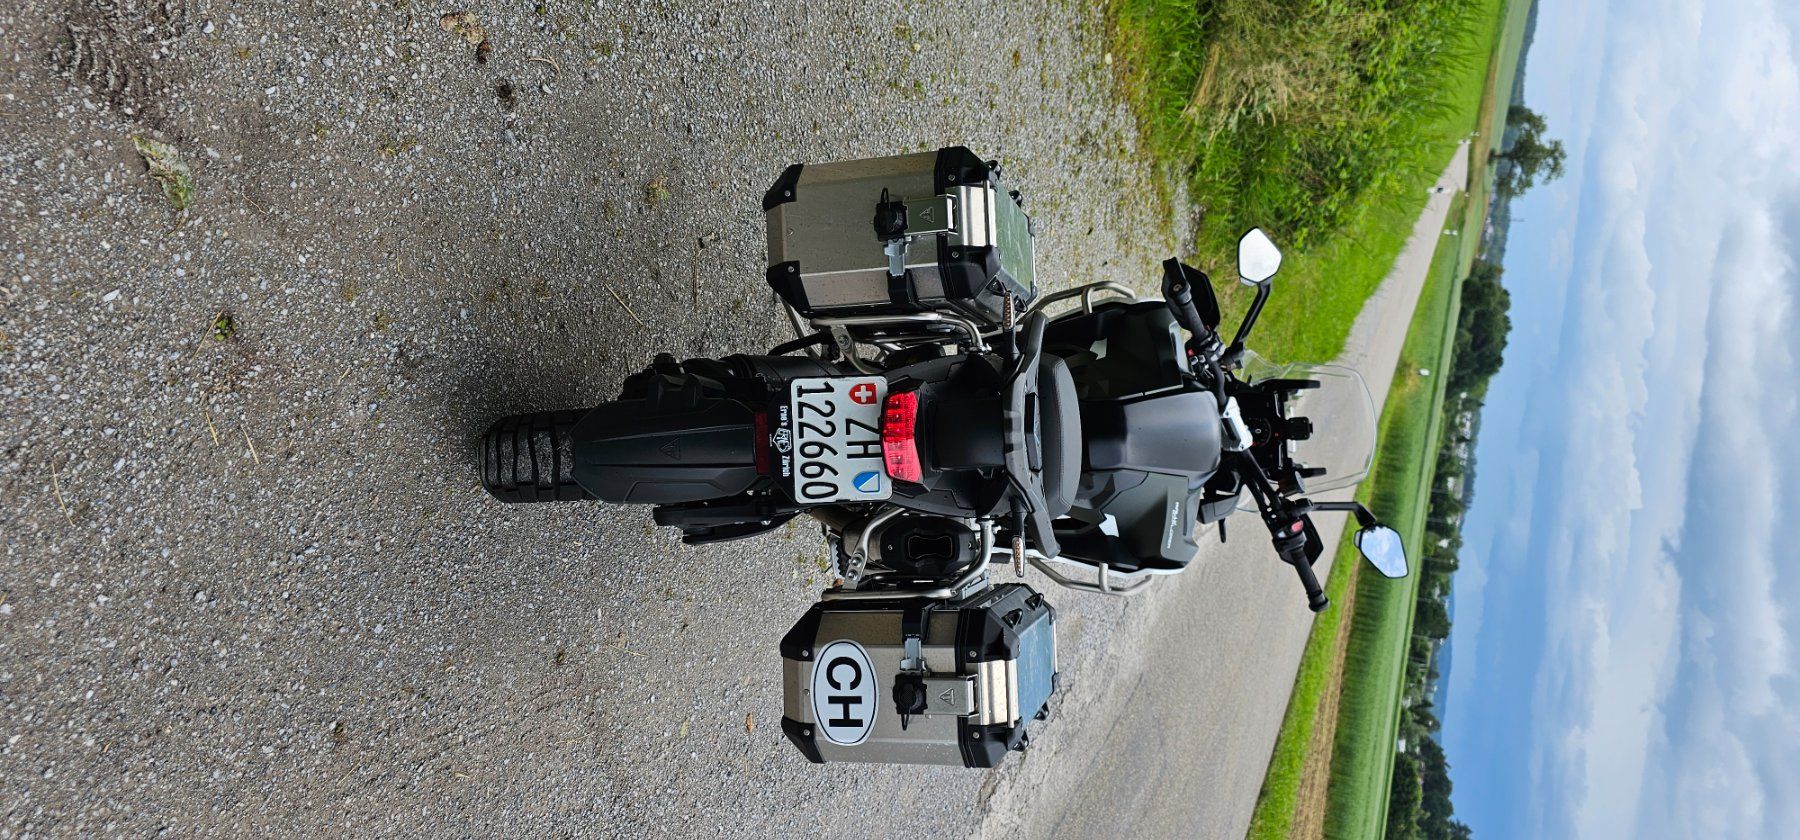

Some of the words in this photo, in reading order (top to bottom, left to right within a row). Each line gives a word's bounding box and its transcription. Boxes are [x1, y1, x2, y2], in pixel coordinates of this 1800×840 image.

[781, 455, 791, 477] Zürich
[796, 381, 839, 500] 122660
[845, 416, 882, 460] ZH
[826, 655, 864, 727] CH
